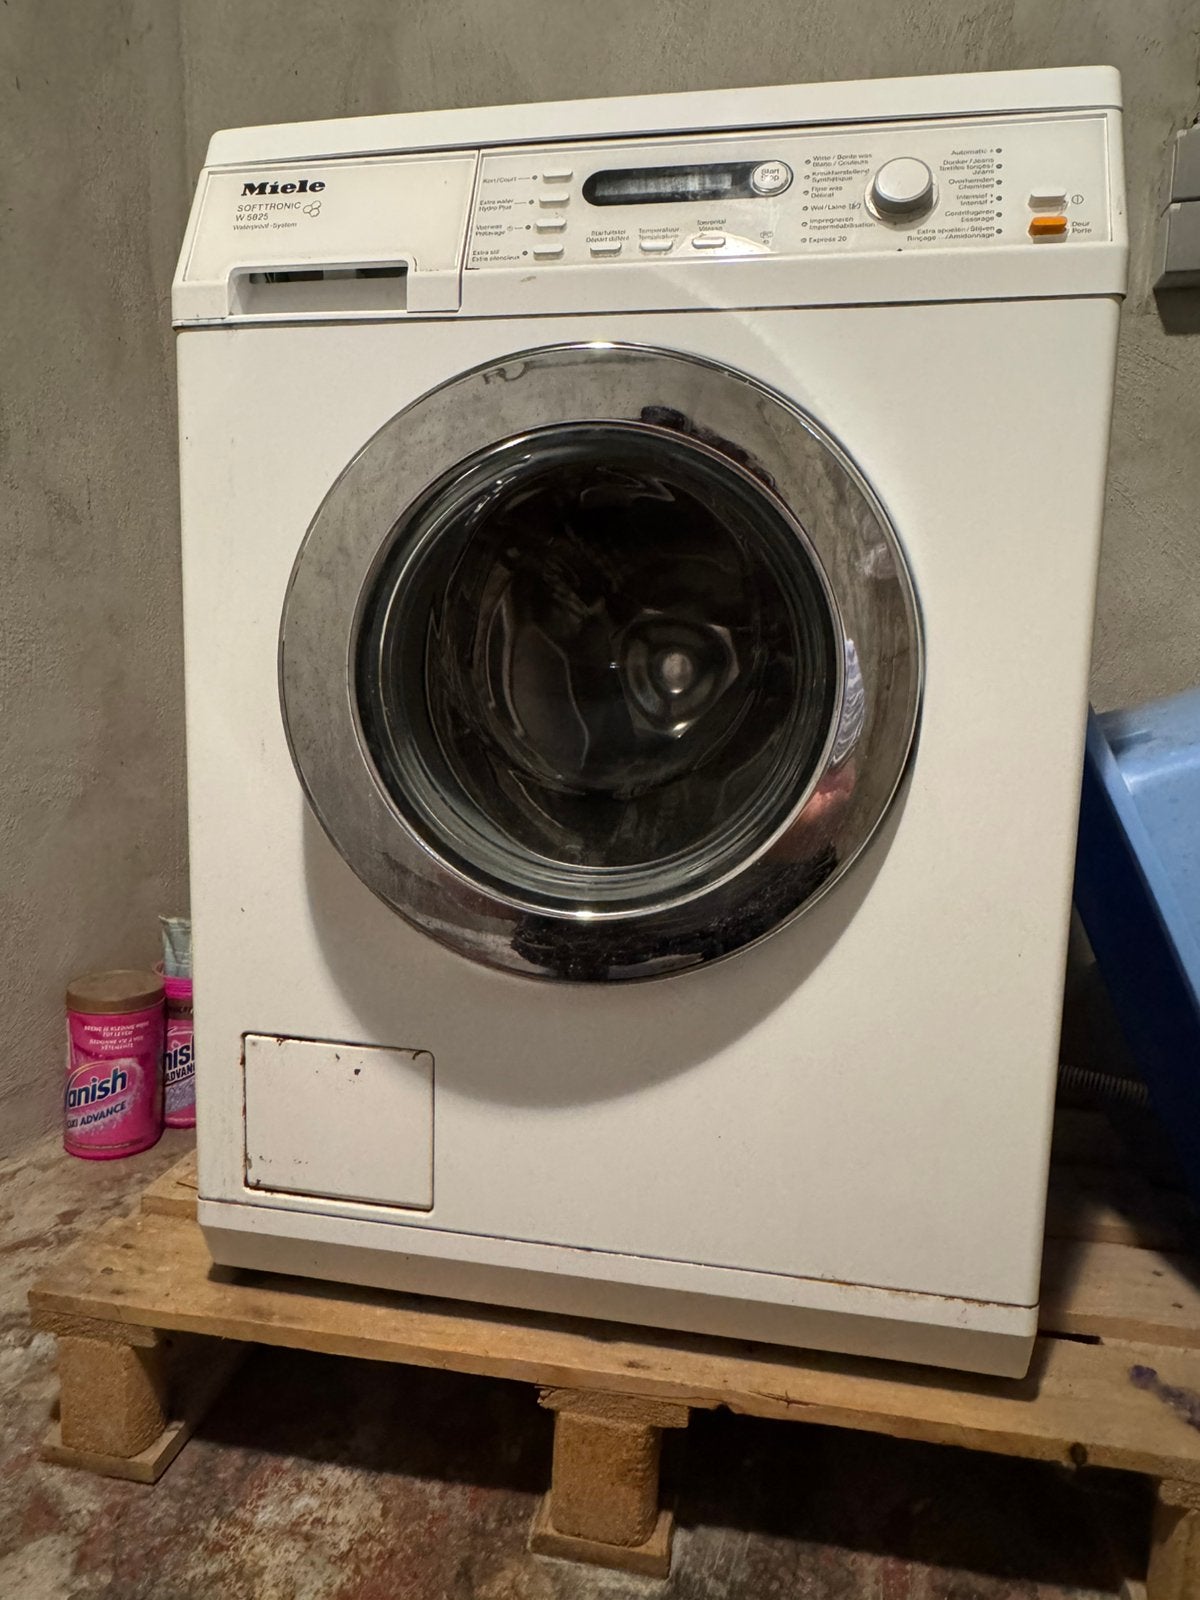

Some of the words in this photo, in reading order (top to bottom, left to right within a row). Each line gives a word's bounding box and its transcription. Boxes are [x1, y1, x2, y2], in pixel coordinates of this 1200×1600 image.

[241, 179, 326, 196] Miele
[237, 201, 302, 213] SOFTTRONIC
[235, 213, 246, 221] W
[80, 1100, 126, 1126] ADVANCE
